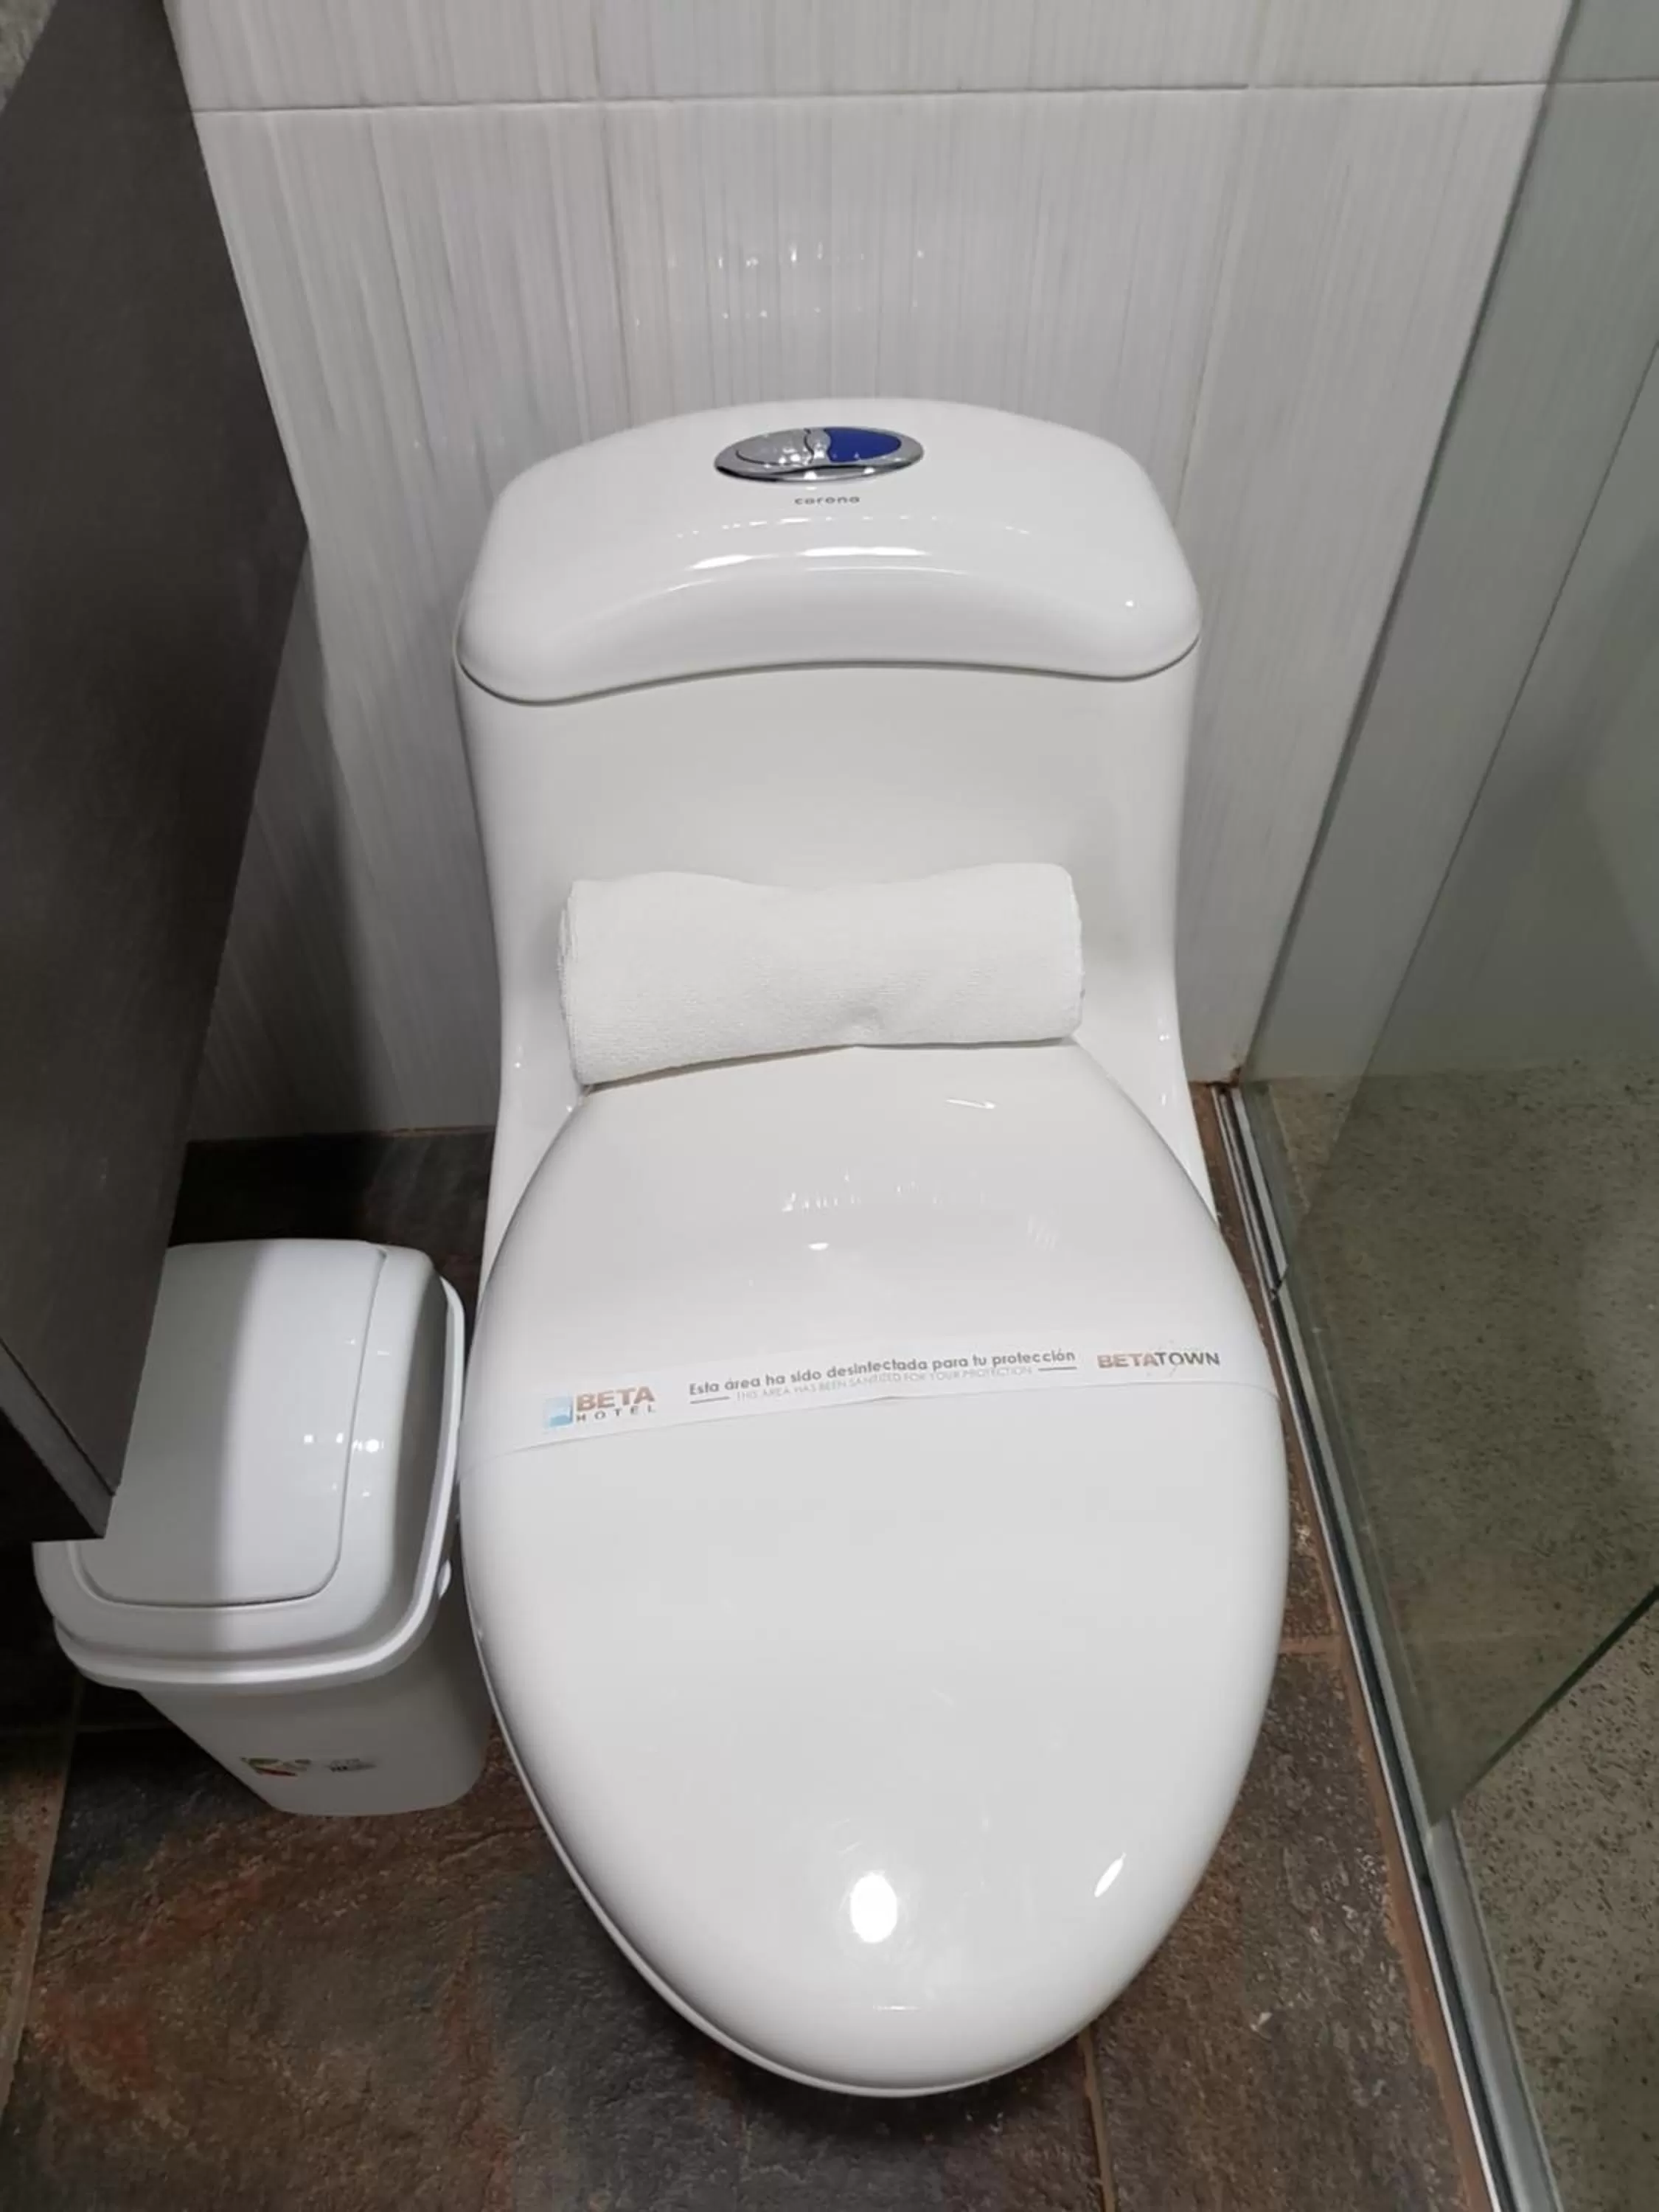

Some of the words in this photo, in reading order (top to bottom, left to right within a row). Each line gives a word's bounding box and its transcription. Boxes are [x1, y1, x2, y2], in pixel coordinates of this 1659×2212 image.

[794, 495, 860, 505] corona
[1096, 1351, 1221, 1369] BETATOWN
[689, 1382, 719, 1396] Esta
[724, 1376, 760, 1391] área
[765, 1374, 785, 1386] ha
[790, 1368, 821, 1383] sido
[827, 1357, 928, 1379] desinfectada
[933, 1355, 968, 1371] para
[973, 1354, 987, 1367] tu
[992, 1348, 1076, 1368] protección
[576, 1385, 655, 1412] BETA
[575, 1404, 656, 1422] HOTEL
